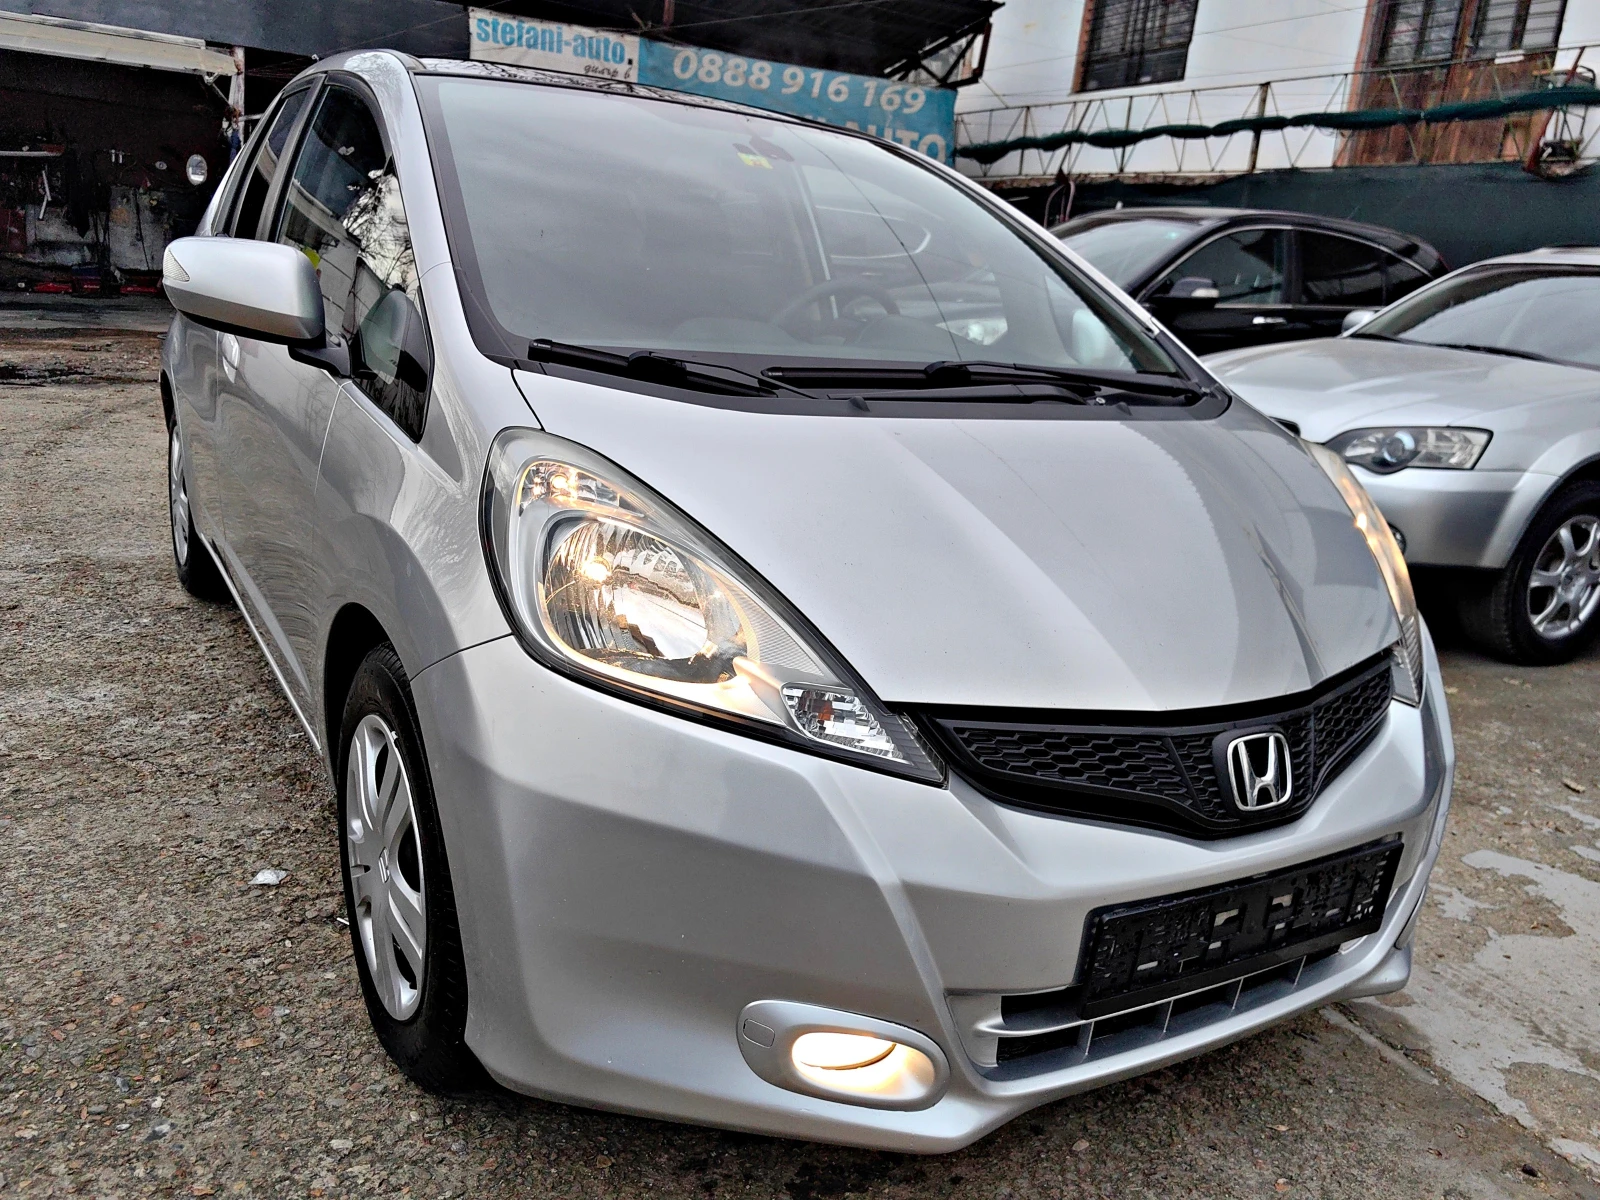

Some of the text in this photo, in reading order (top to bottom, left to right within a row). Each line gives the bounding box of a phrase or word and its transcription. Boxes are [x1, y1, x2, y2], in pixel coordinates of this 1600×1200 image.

[673, 49, 926, 114] 0888 916 169
